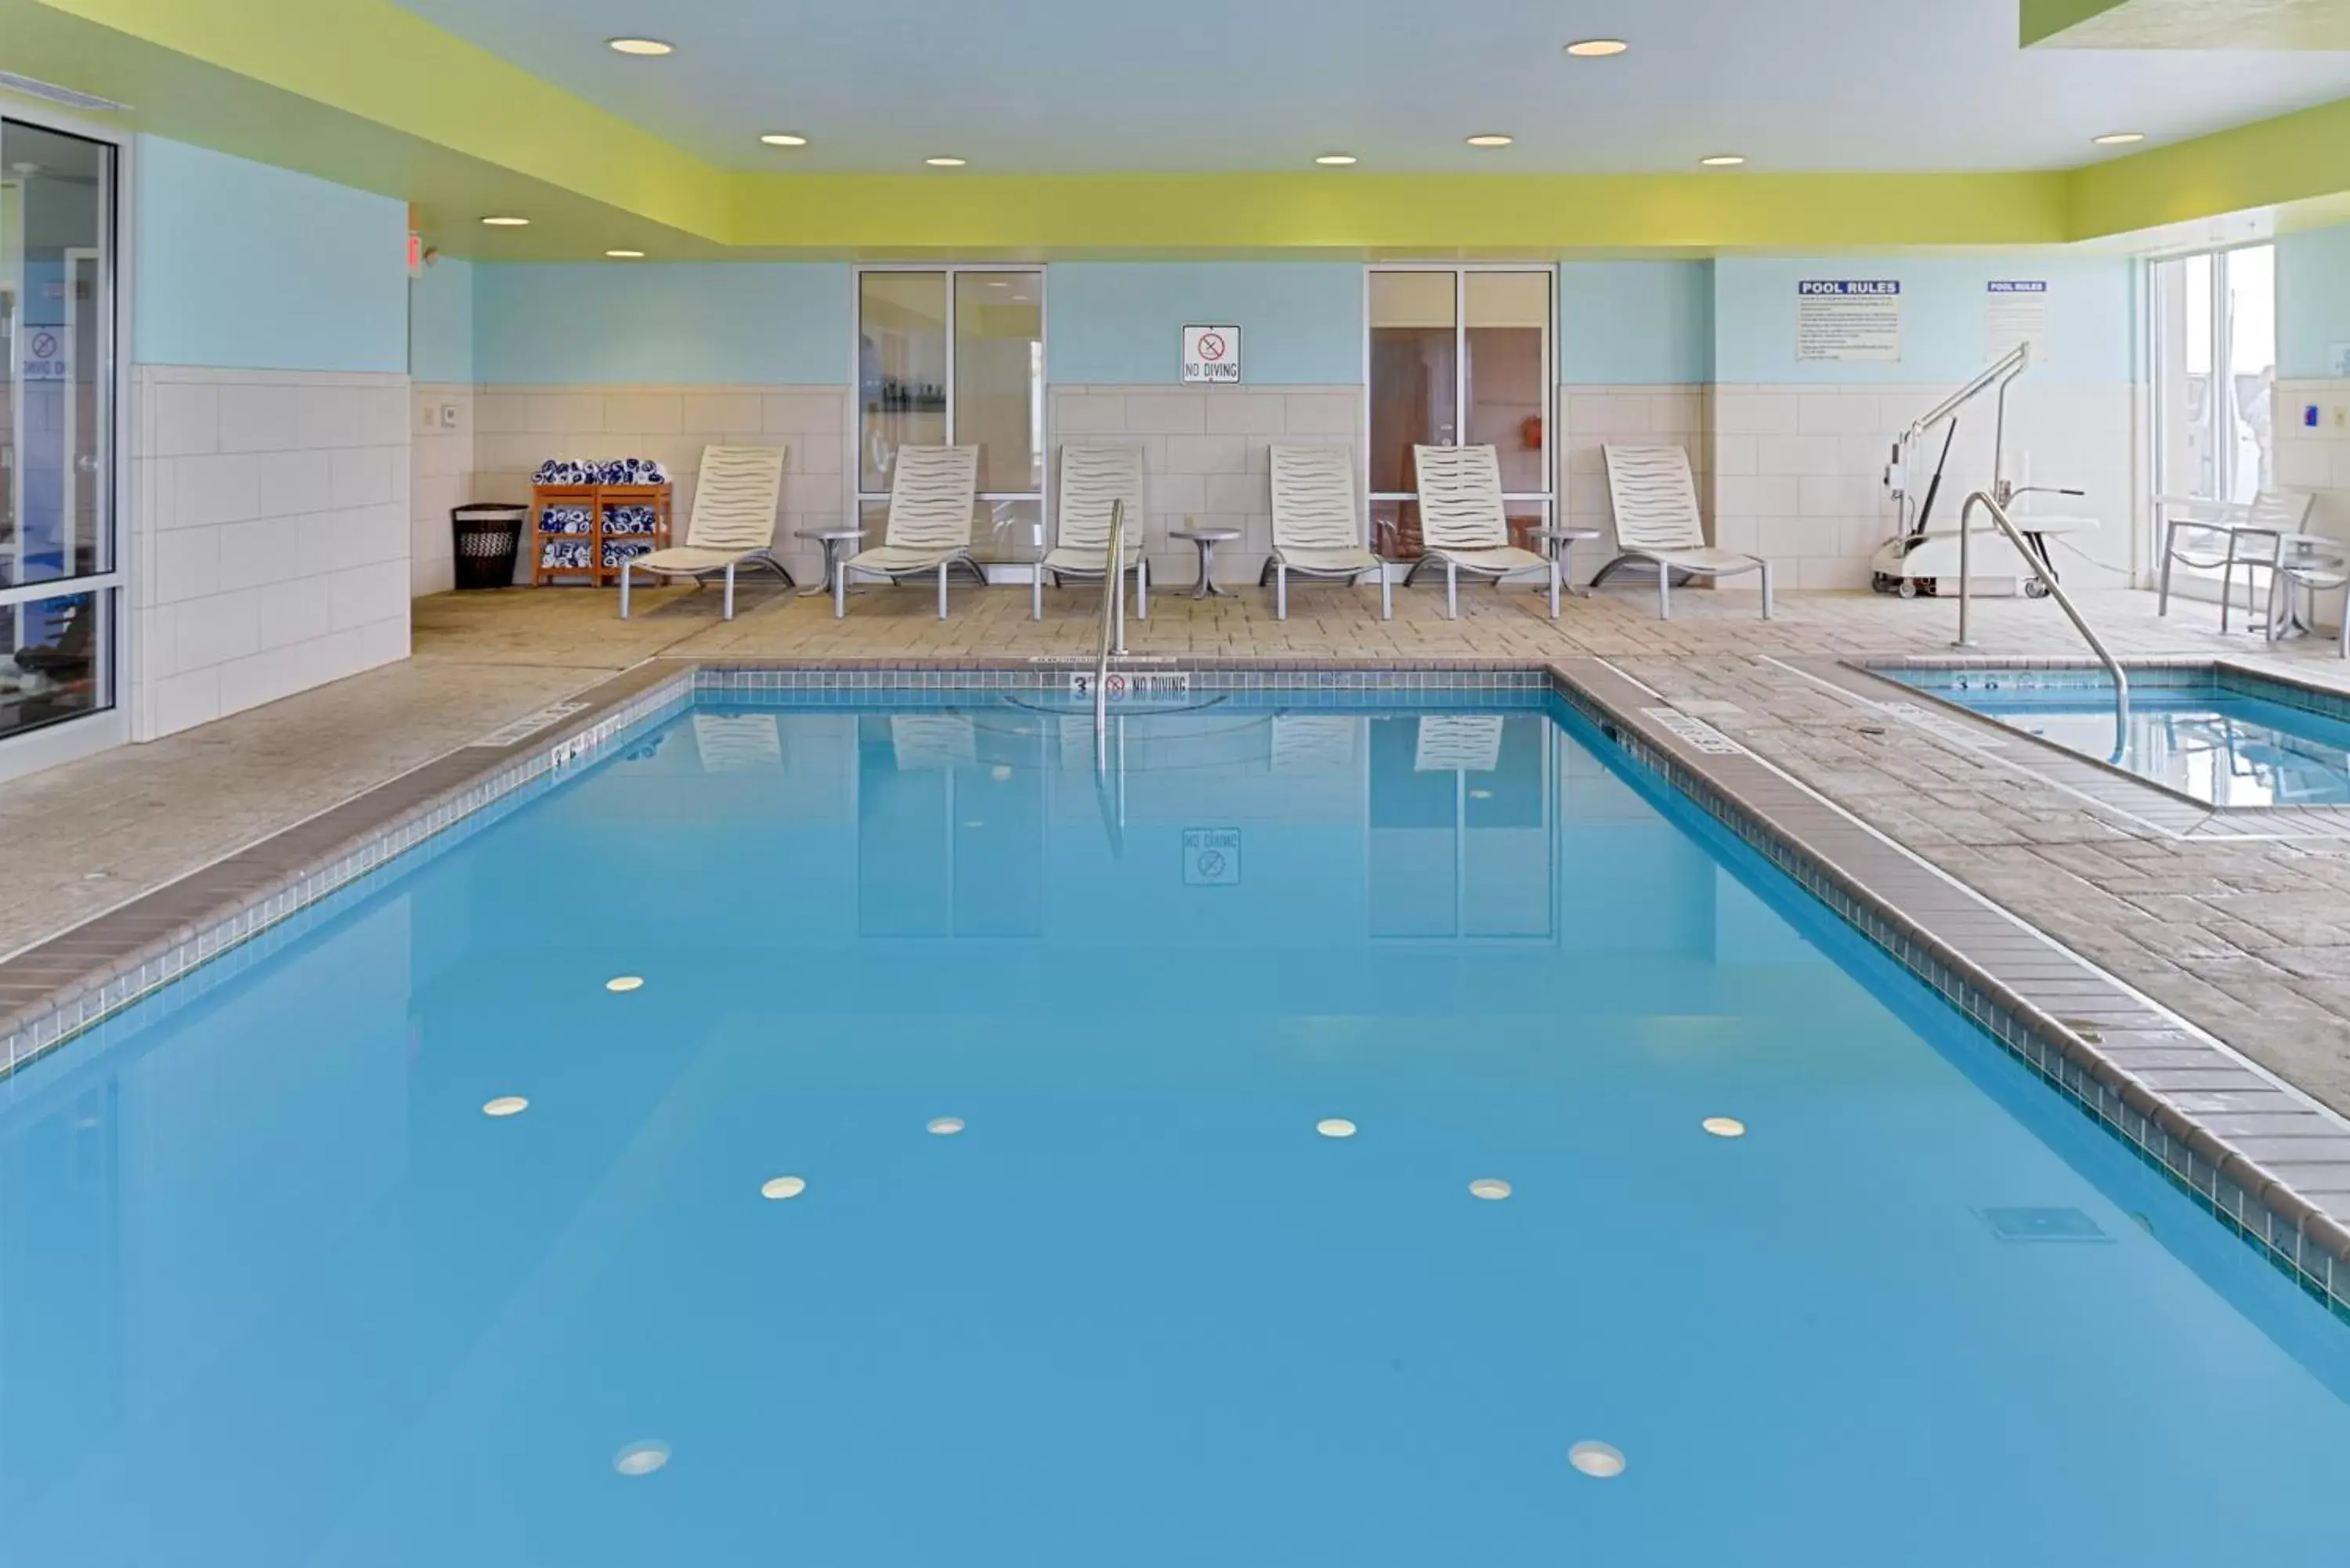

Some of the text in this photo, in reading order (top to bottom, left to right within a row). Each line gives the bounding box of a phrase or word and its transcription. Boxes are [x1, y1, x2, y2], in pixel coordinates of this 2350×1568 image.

[1802, 282, 1896, 294] POOL RULES
[1185, 363, 1237, 377] NO DIVING
[1075, 677, 1086, 691] 3
[1132, 677, 1186, 691] NO DIVING
